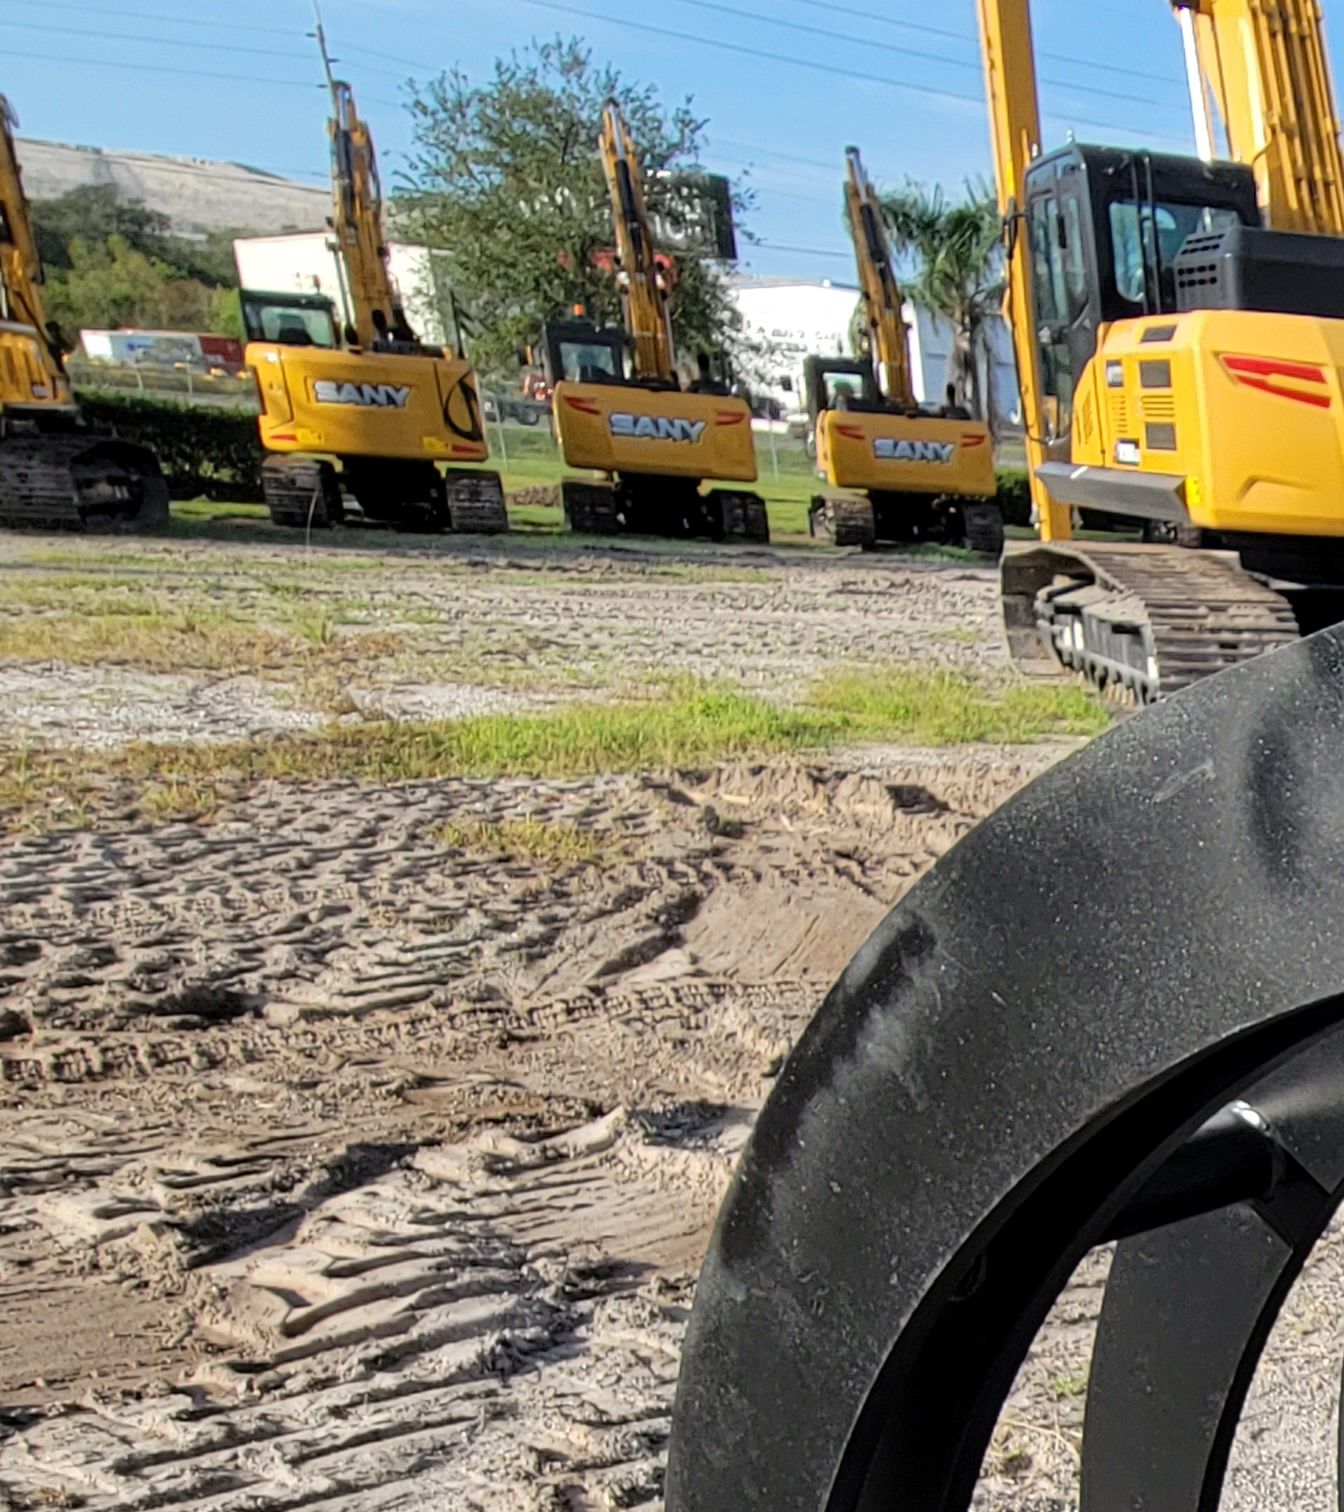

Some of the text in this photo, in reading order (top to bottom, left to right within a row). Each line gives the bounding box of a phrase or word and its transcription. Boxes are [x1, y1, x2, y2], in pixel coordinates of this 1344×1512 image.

[313, 380, 410, 407] SANY
[609, 412, 707, 444] SANY
[873, 437, 956, 464] SANY
